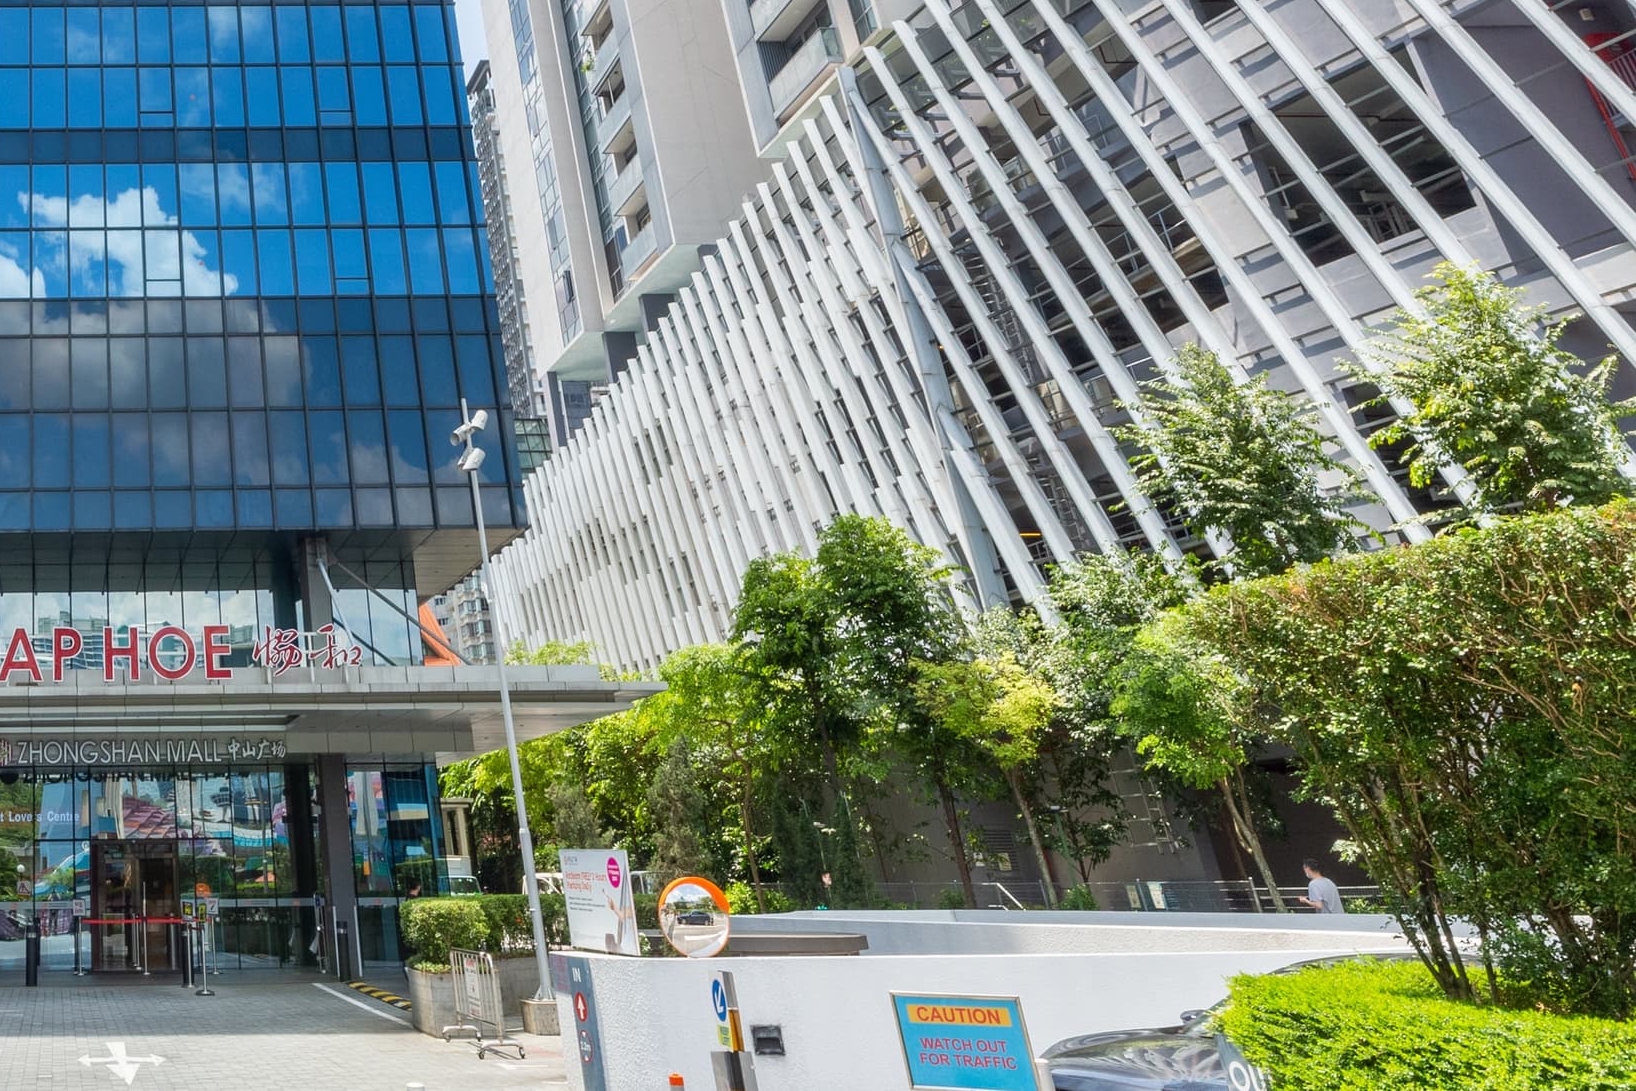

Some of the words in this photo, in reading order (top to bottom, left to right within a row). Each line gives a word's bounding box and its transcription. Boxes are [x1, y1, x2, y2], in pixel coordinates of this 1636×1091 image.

[103, 624, 233, 682] HOE
[17, 740, 160, 764] ZHONGSHAN
[167, 741, 222, 763] MALL
[227, 738, 287, 761] 中山广场
[47, 811, 80, 821] Centre
[572, 967, 582, 983] IN
[915, 1006, 1001, 1025] CAUTION
[920, 1037, 972, 1053] WATCH
[976, 1038, 1007, 1054] OUT
[920, 1052, 950, 1067] FOR
[953, 1053, 1017, 1071] TRAFFIC
